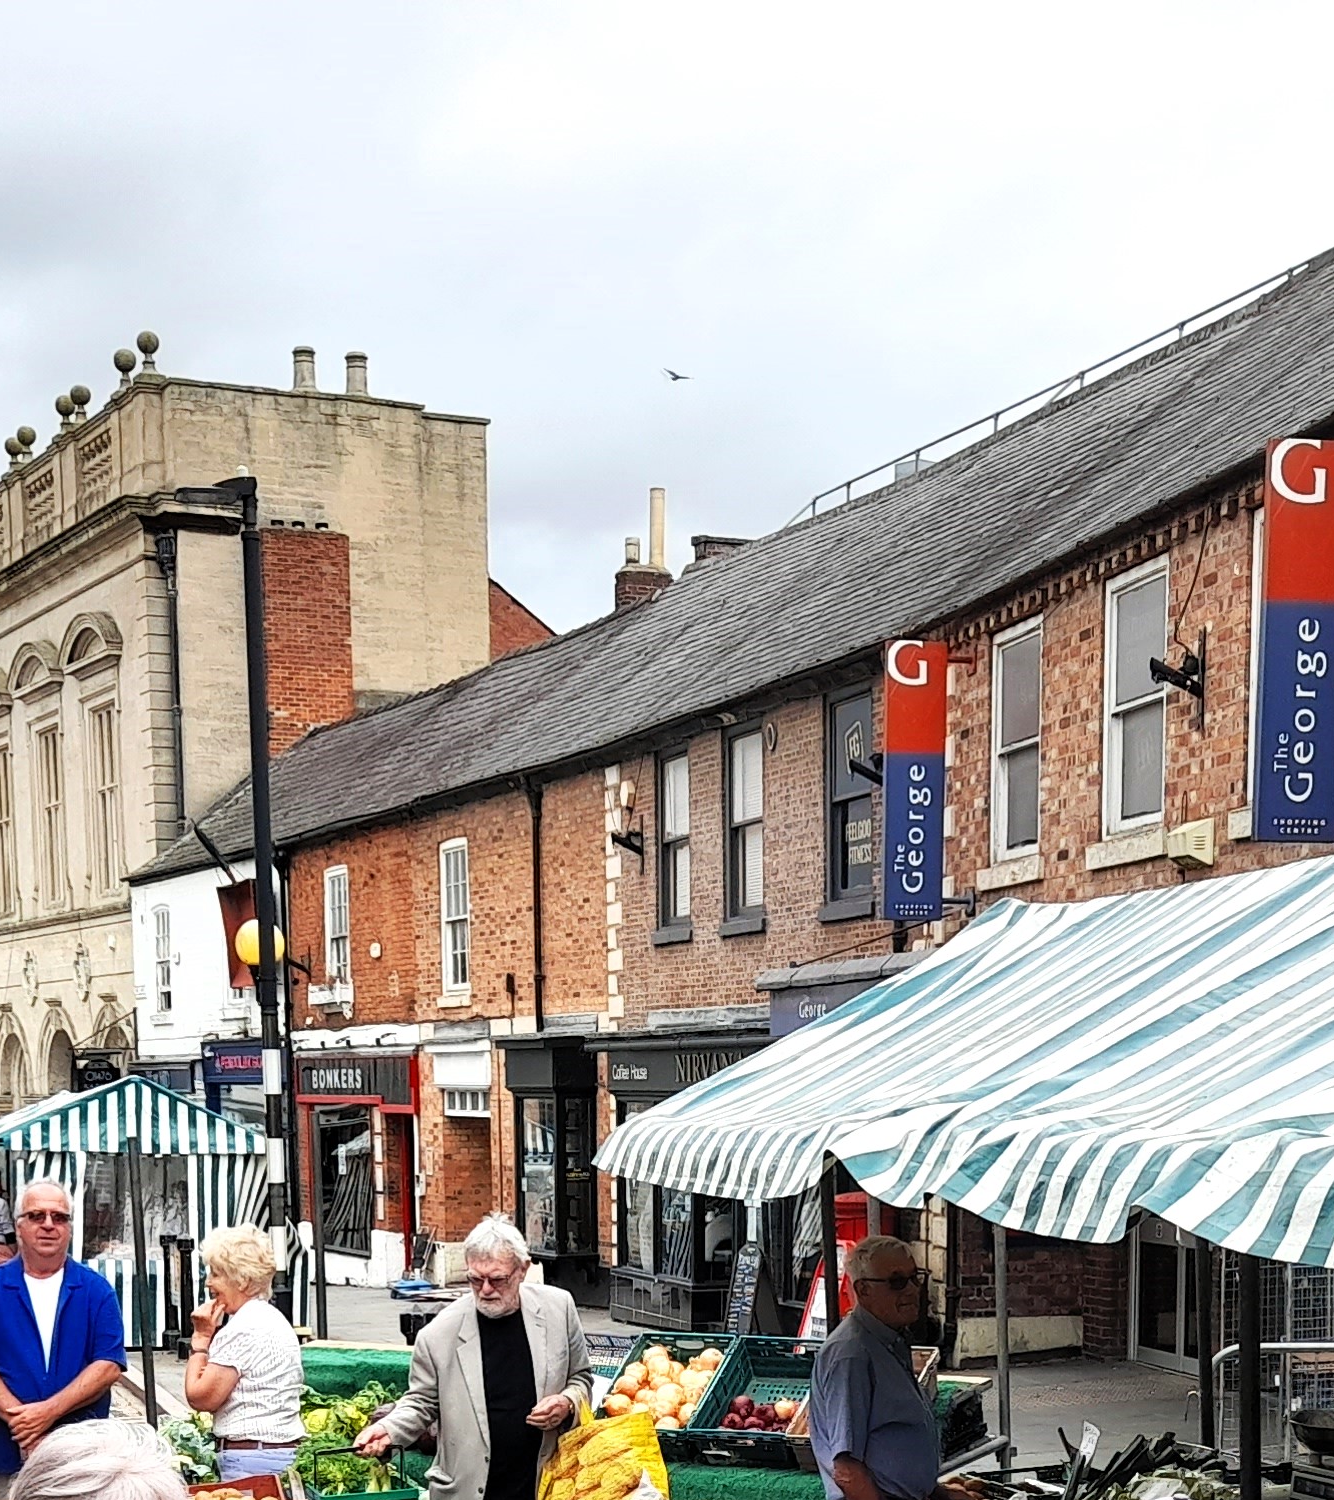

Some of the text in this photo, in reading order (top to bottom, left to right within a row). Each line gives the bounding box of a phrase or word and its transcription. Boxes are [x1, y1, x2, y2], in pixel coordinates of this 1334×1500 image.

[1270, 439, 1327, 503] G
[887, 639, 928, 685] G
[1284, 617, 1328, 802] George
[1274, 732, 1289, 772] The
[846, 819, 872, 842] FEELGOO
[902, 764, 932, 893] George
[1273, 818, 1327, 827] SHOPPING
[1279, 827, 1320, 835] CENTRE
[894, 844, 905, 872] The
[799, 1001, 827, 1019] George
[311, 1068, 362, 1089] BONKERS
[630, 1065, 648, 1081] House
[674, 1051, 744, 1083] NIRVAN
